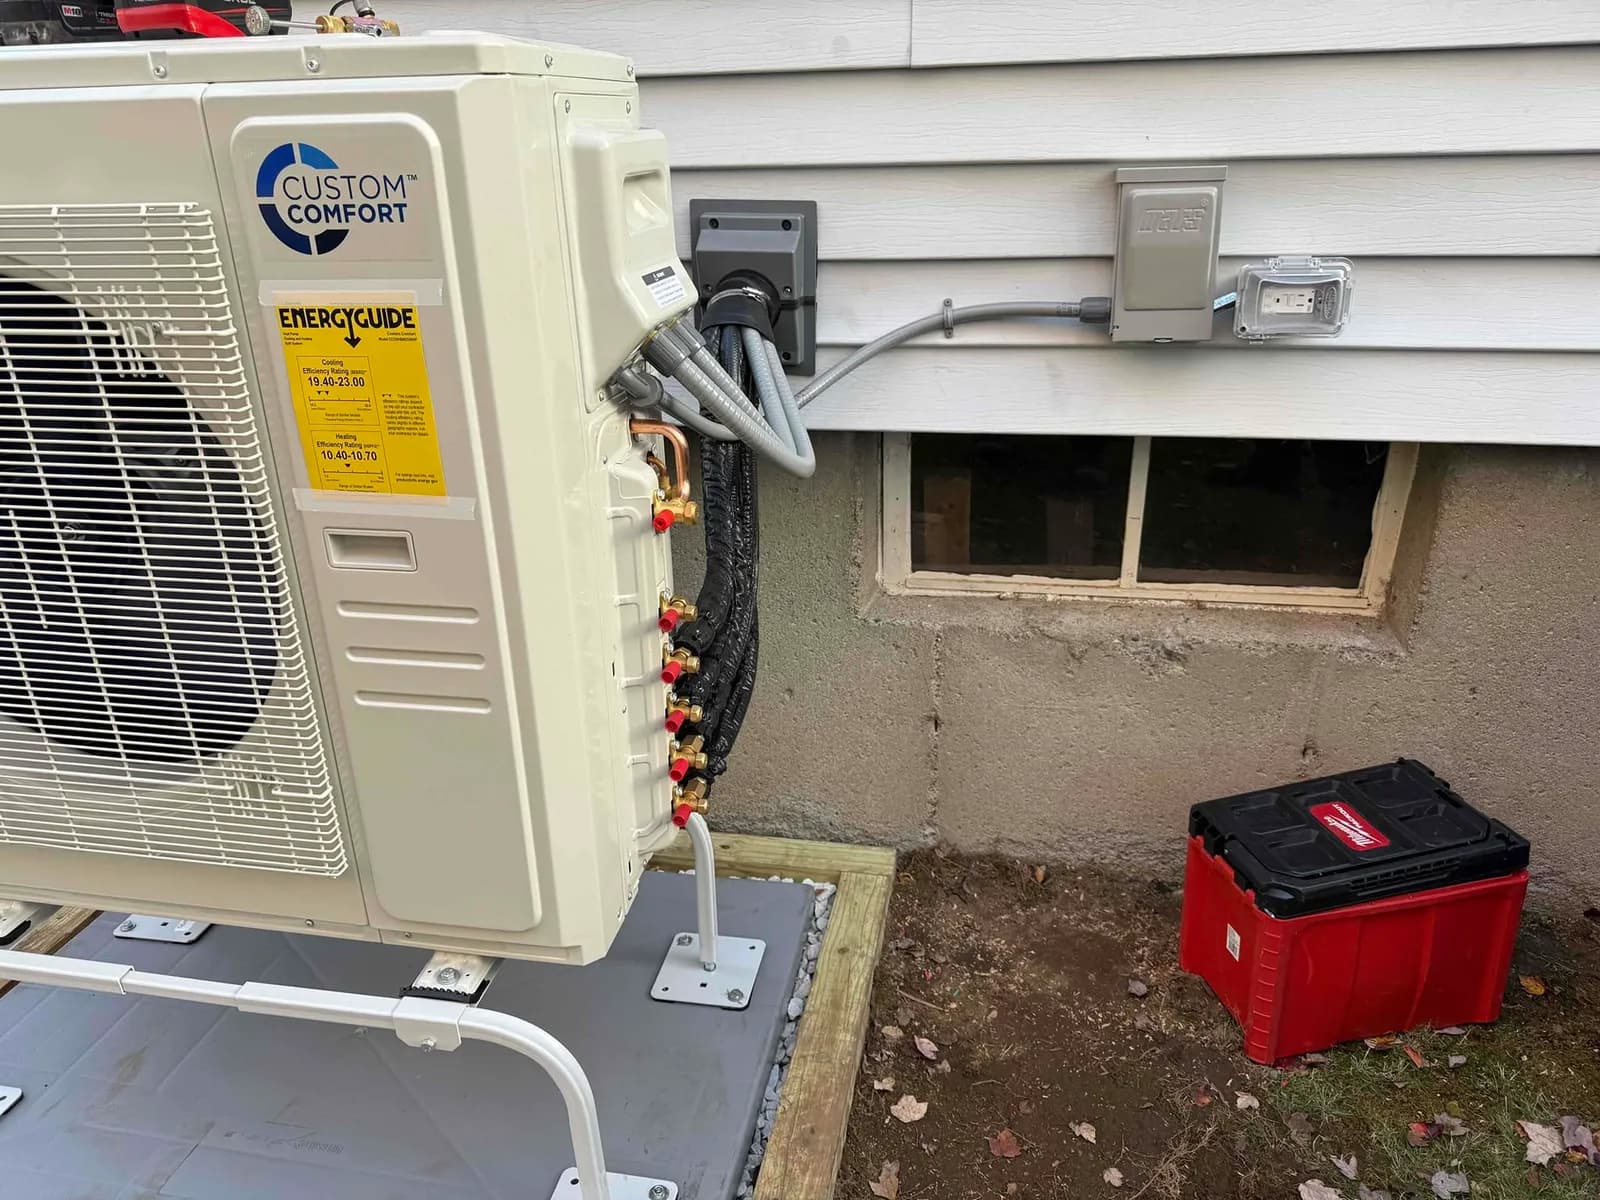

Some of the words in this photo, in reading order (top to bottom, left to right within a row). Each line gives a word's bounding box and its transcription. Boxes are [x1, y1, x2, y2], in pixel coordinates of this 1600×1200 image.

[283, 175, 406, 200] CUSTOM
[287, 203, 408, 224] COMFORT
[279, 308, 416, 329] ENERGYGUIDE
[321, 359, 344, 367] Cooling
[302, 368, 330, 376] Efficiency
[331, 368, 349, 376] Rating
[308, 376, 365, 387] 19.40-23.00
[316, 441, 343, 449] Efficiency
[344, 441, 362, 449] Rating
[321, 450, 377, 461] 10.40-10.70
